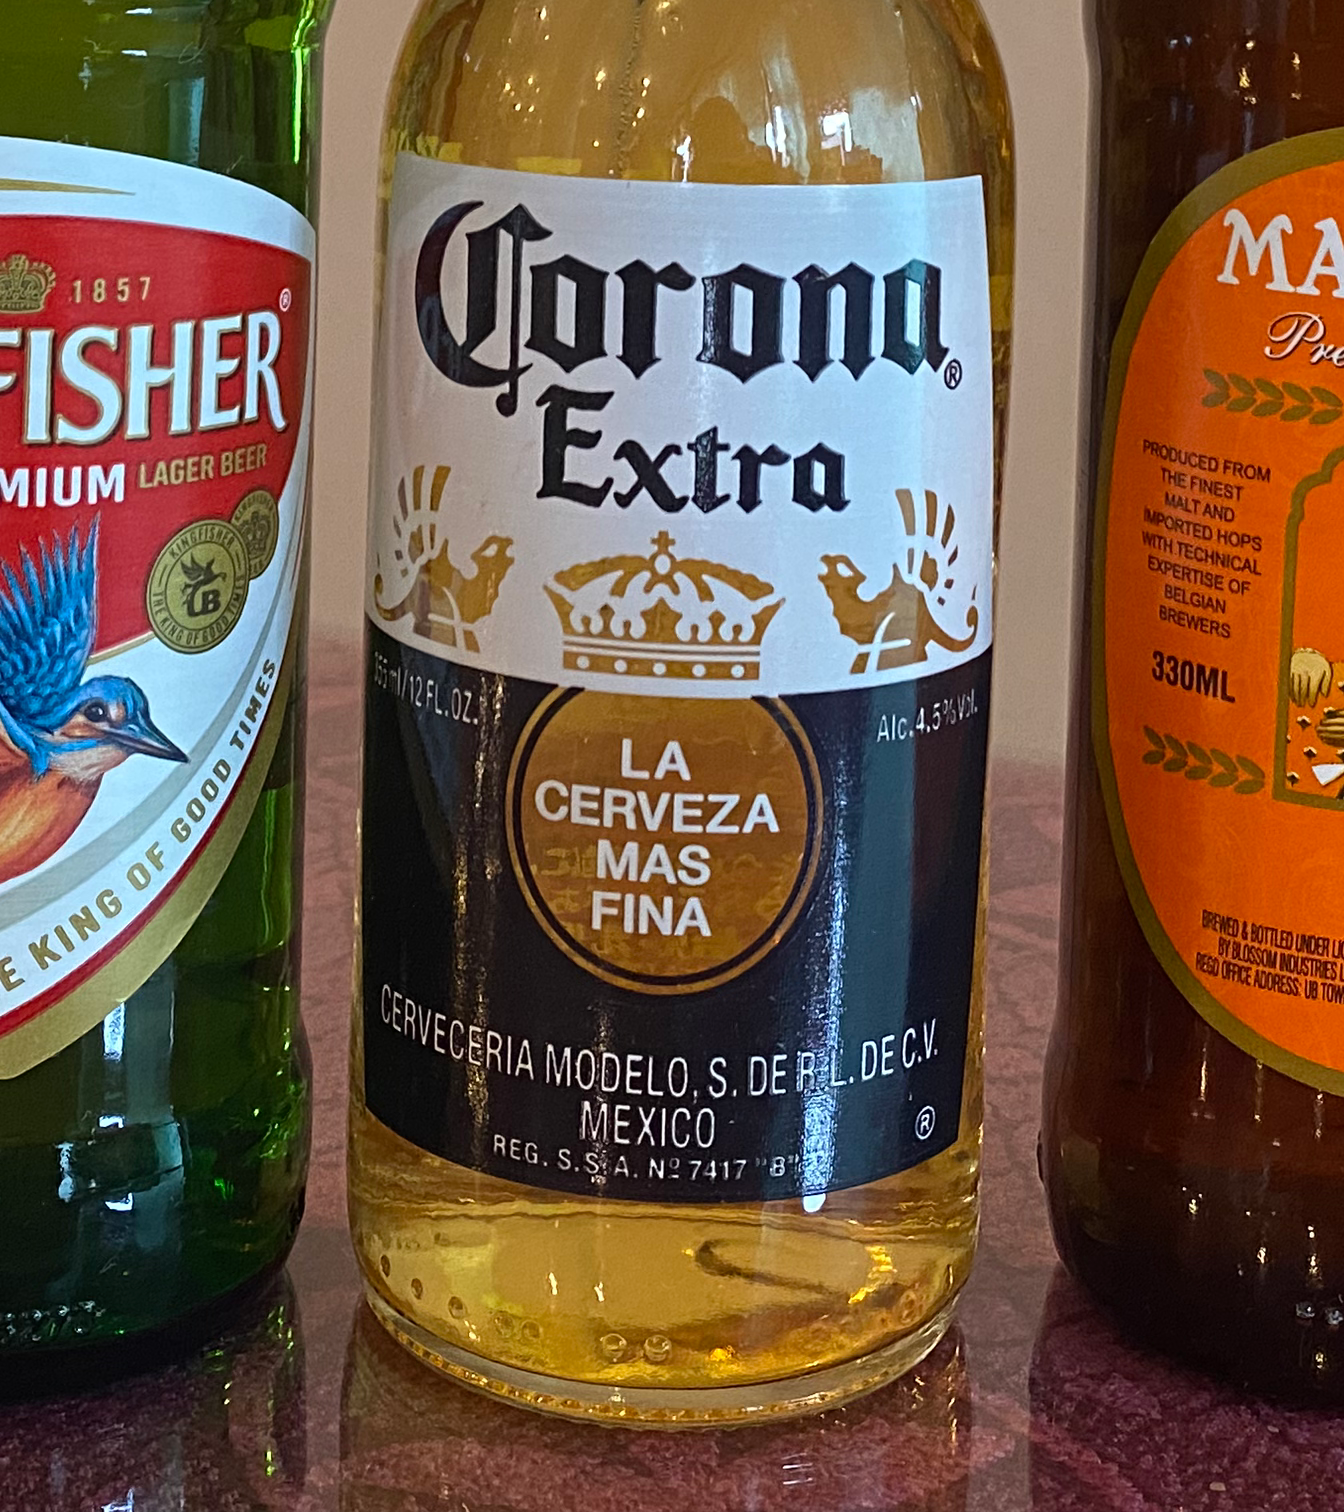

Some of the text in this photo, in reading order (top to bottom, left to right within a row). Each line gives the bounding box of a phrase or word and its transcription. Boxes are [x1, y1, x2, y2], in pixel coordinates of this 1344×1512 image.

[72, 277, 152, 305] 1857
[414, 200, 949, 417] Corona
[138, 459, 215, 490] LAGER
[220, 441, 268, 478] BEER
[535, 384, 850, 513] Extra
[1142, 438, 1271, 483] PRODUCED FROM
[1160, 467, 1244, 501] THE FINEST
[1143, 508, 1262, 552] IMPORTED HOPS
[1164, 492, 1235, 523] MALT AND
[169, 524, 238, 560] KINGFISHER
[1142, 531, 1261, 576] WITH TECHNICAL
[1148, 556, 1251, 596] EXPERTISE OF
[1164, 584, 1226, 614] BELGIAN
[1159, 605, 1231, 639] BREWERS
[1152, 650, 1236, 704] 330ML
[620, 738, 692, 781] LA
[28, 888, 123, 971] KING
[126, 841, 165, 892] OF
[170, 758, 231, 843] GOOD
[230, 657, 277, 751] TIMES
[533, 779, 780, 834] CERVEZA
[595, 839, 711, 886] MAS
[590, 890, 712, 937] FINA
[1202, 909, 1239, 937] BREWED
[1241, 921, 1248, 940] &
[1251, 923, 1293, 951] BOTTLED
[1295, 934, 1330, 957] UNDER
[1218, 937, 1231, 957] BY
[1232, 941, 1277, 969] BLOSSOM
[1280, 952, 1337, 980] INDUSTRIES
[1222, 960, 1252, 985] OFFICE
[1305, 980, 1318, 999] UB
[381, 983, 938, 1104] CERVECERIA MODELO, S. DE DE C.V.
[579, 1100, 715, 1149] MEXICO
[493, 1133, 548, 1167] REG.
[688, 1159, 747, 1181] 7417
